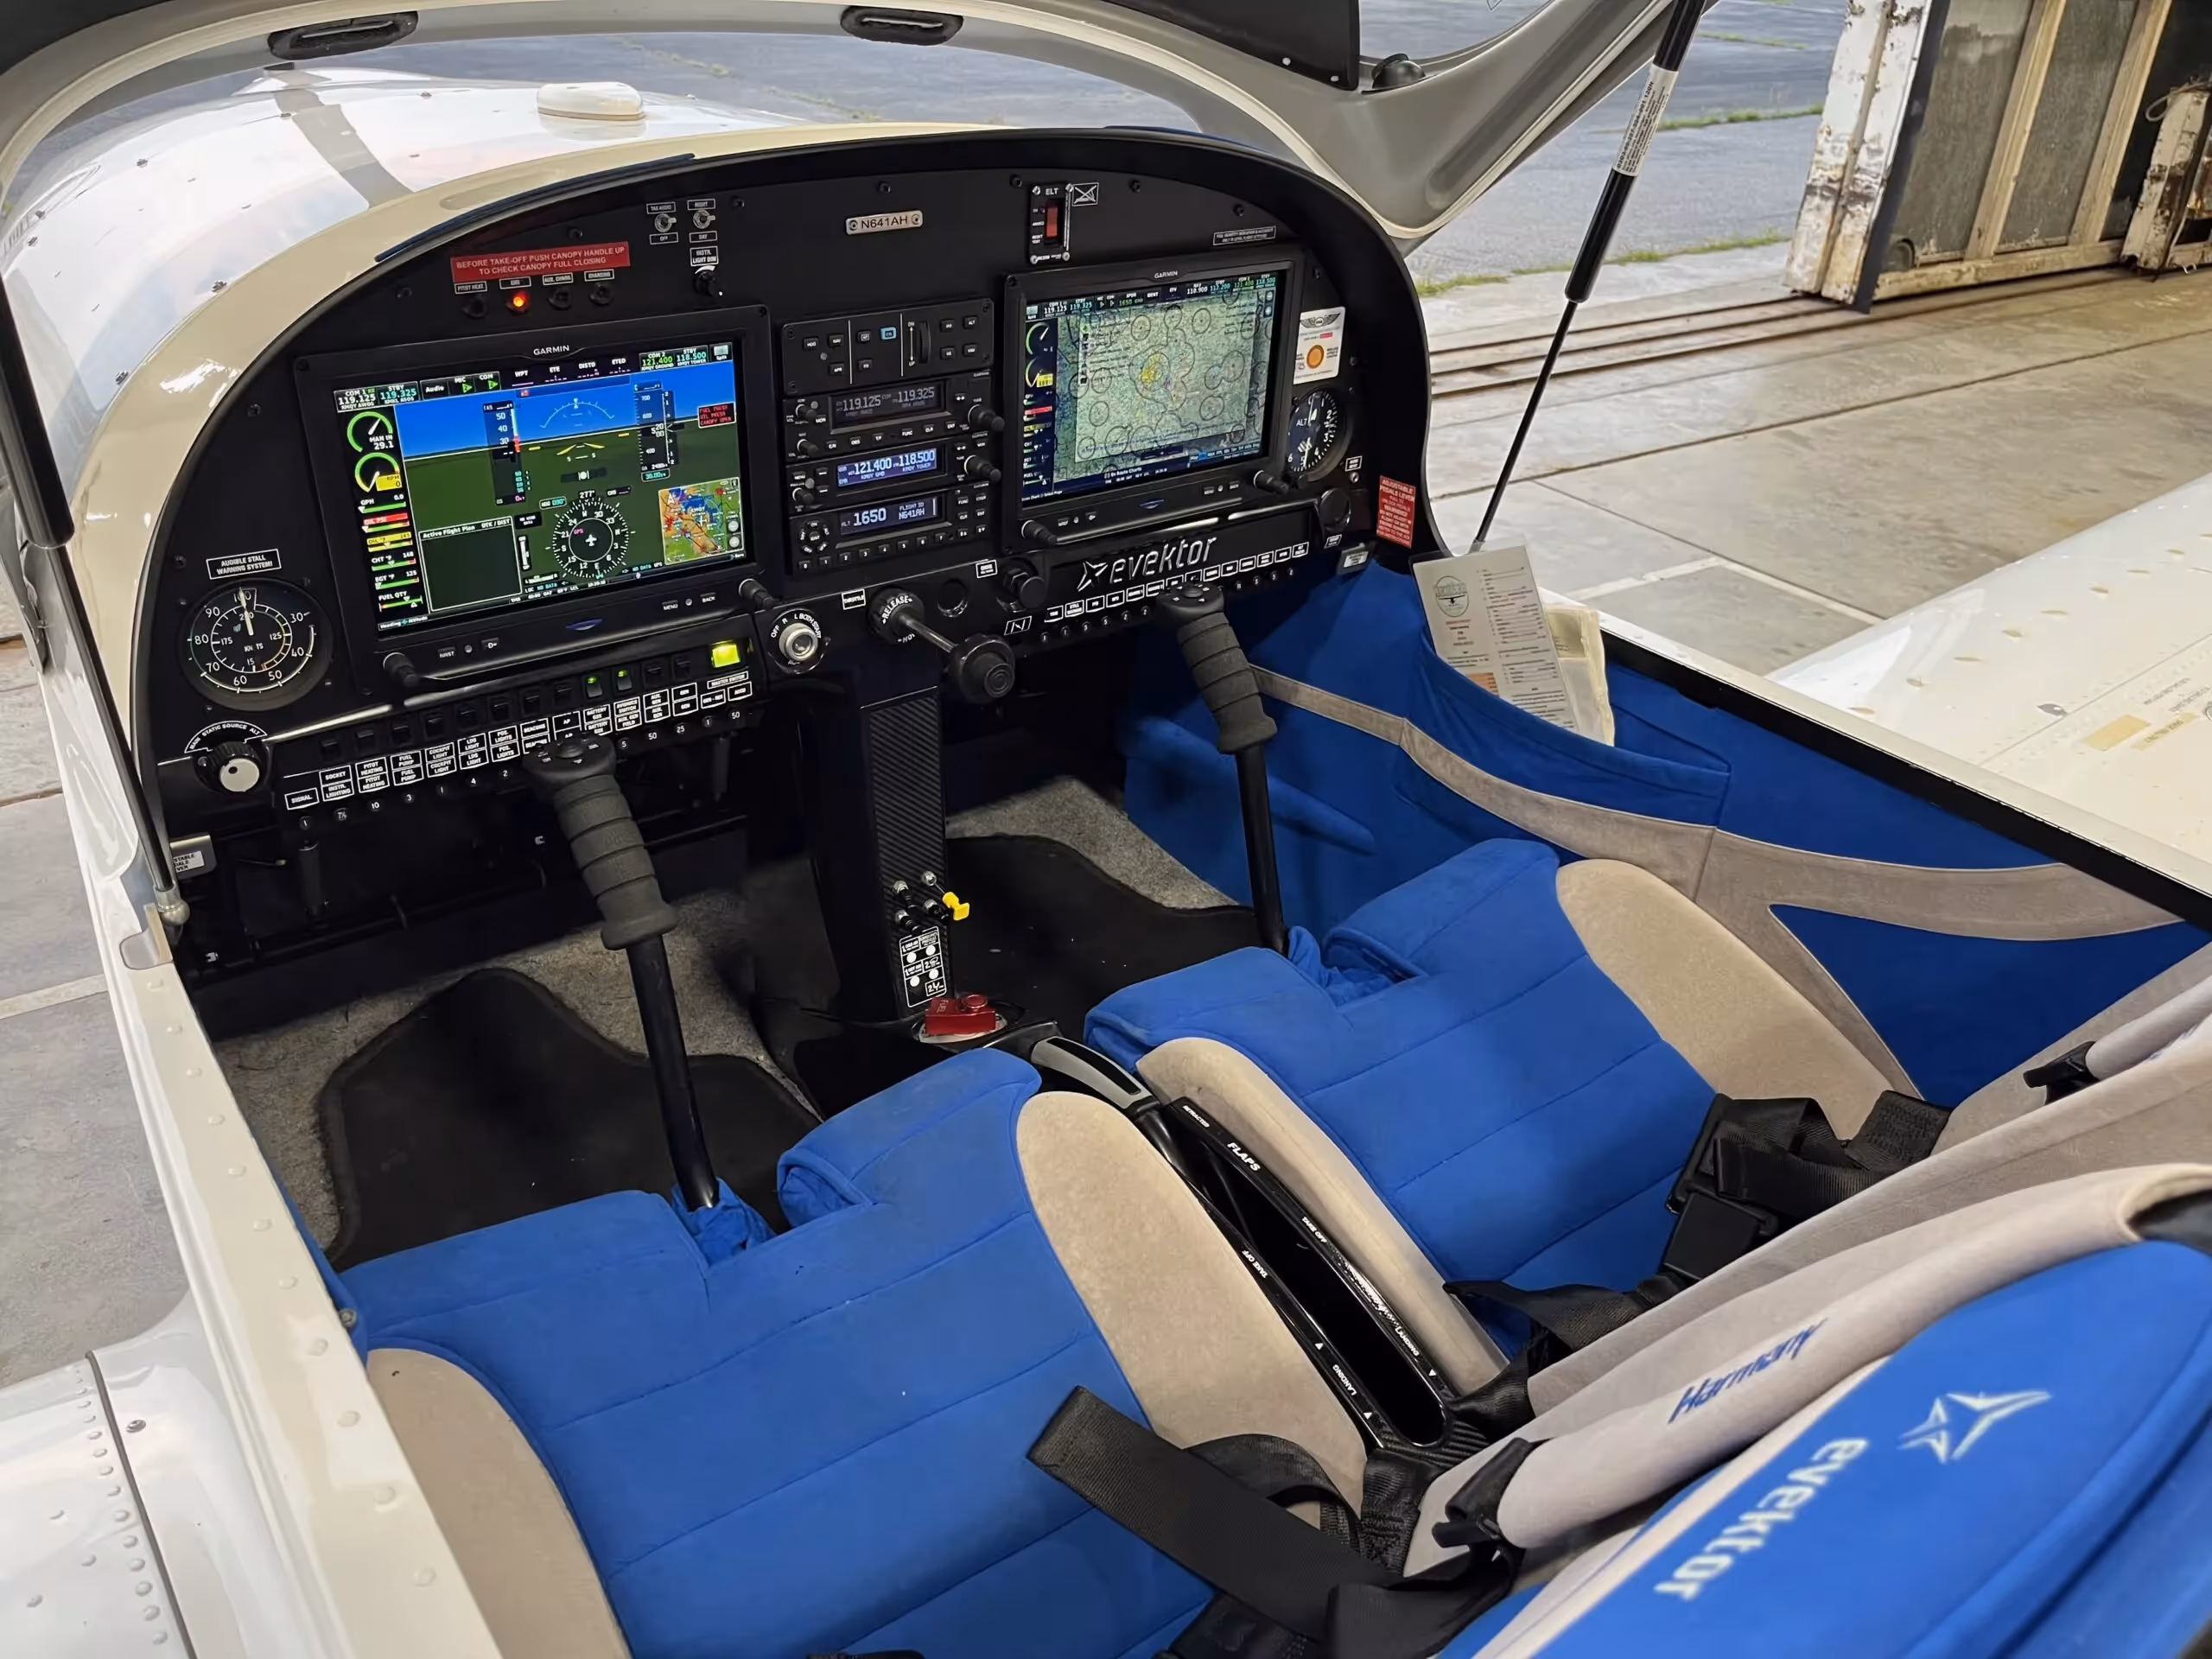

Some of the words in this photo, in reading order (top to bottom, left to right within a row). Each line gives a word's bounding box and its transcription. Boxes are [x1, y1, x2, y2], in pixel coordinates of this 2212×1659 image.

[861, 215, 908, 229] N641AH
[456, 259, 487, 269] BEFORE
[490, 256, 527, 265] TAKE-OFF
[529, 254, 550, 263] PUSH
[551, 251, 583, 262] CANOPY
[583, 248, 613, 258] HANDLE
[492, 264, 518, 274] CHECK
[520, 262, 552, 272] CANOPY
[574, 257, 607, 267] CLOSING
[1154, 270, 1179, 279] GARMIN
[1044, 306, 1067, 315] 119.125
[1070, 302, 1092, 311] 119.325
[533, 345, 570, 356] GARMIN
[642, 356, 673, 366] 121.400
[677, 351, 707, 362] 118.500
[379, 389, 417, 400] 119.325
[425, 385, 444, 393] Audio
[338, 394, 376, 406] 119.125
[842, 395, 881, 411] 119.125
[898, 387, 935, 404] 119.325
[1326, 410, 1332, 420] 2
[498, 424, 508, 433] 40
[1323, 433, 1329, 442] 3
[374, 442, 394, 450] 29.1
[855, 458, 892, 475] 121.400
[899, 450, 936, 467] 118.500
[1287, 453, 1293, 463] 6
[1382, 479, 1414, 493] ADJUSTABLE
[854, 507, 887, 526] 1650
[899, 507, 925, 520] N641AH
[423, 530, 442, 539] Active
[442, 527, 461, 536] Flight
[221, 558, 246, 567] AUDIBLE
[248, 555, 266, 563] STALL
[1109, 537, 1217, 584] evektor
[217, 566, 245, 575] WARNING
[394, 590, 408, 599] QTY
[206, 607, 219, 618] 90
[883, 595, 909, 620] RELEASE
[290, 613, 303, 623] 30
[798, 613, 814, 624] BOTH
[771, 625, 780, 639] OFF
[811, 620, 822, 639] START
[194, 634, 209, 645] 80
[221, 637, 233, 645] 175
[291, 647, 304, 657] 40
[206, 662, 219, 672] 70
[233, 676, 247, 686] 60
[268, 670, 282, 681] 50
[587, 707, 607, 715] BATTERY
[524, 723, 546, 734] BEACONS
[588, 721, 608, 730] BATTERY
[189, 737, 201, 750] MAIN
[201, 725, 221, 737] STATIC
[495, 734, 512, 743] LIGHTS
[429, 746, 450, 754] COCKPIT
[497, 750, 515, 759] LIGHTS
[430, 760, 452, 769] COCKPIT
[325, 772, 346, 780] SOCKET
[361, 767, 384, 776] HEATING
[363, 781, 385, 790] HEATING
[326, 789, 351, 798] LIGHTING
[924, 961, 931, 969] 2
[937, 999, 949, 1014] FUEL
[1182, 1105, 1210, 1128] RETRACTED
[1227, 1142, 1261, 1173] FLAPS
[1301, 1216, 1317, 1233] TAKE
[1313, 1228, 1328, 1244] OFF
[1242, 1249, 1256, 1265] OFF
[1251, 1260, 1268, 1279] TAKE
[1395, 1326, 1420, 1357] LANDING
[1667, 1317, 1828, 1425] Harmony
[1332, 1364, 1357, 1396] LANDING
[1654, 1437, 1869, 1601] evektor
